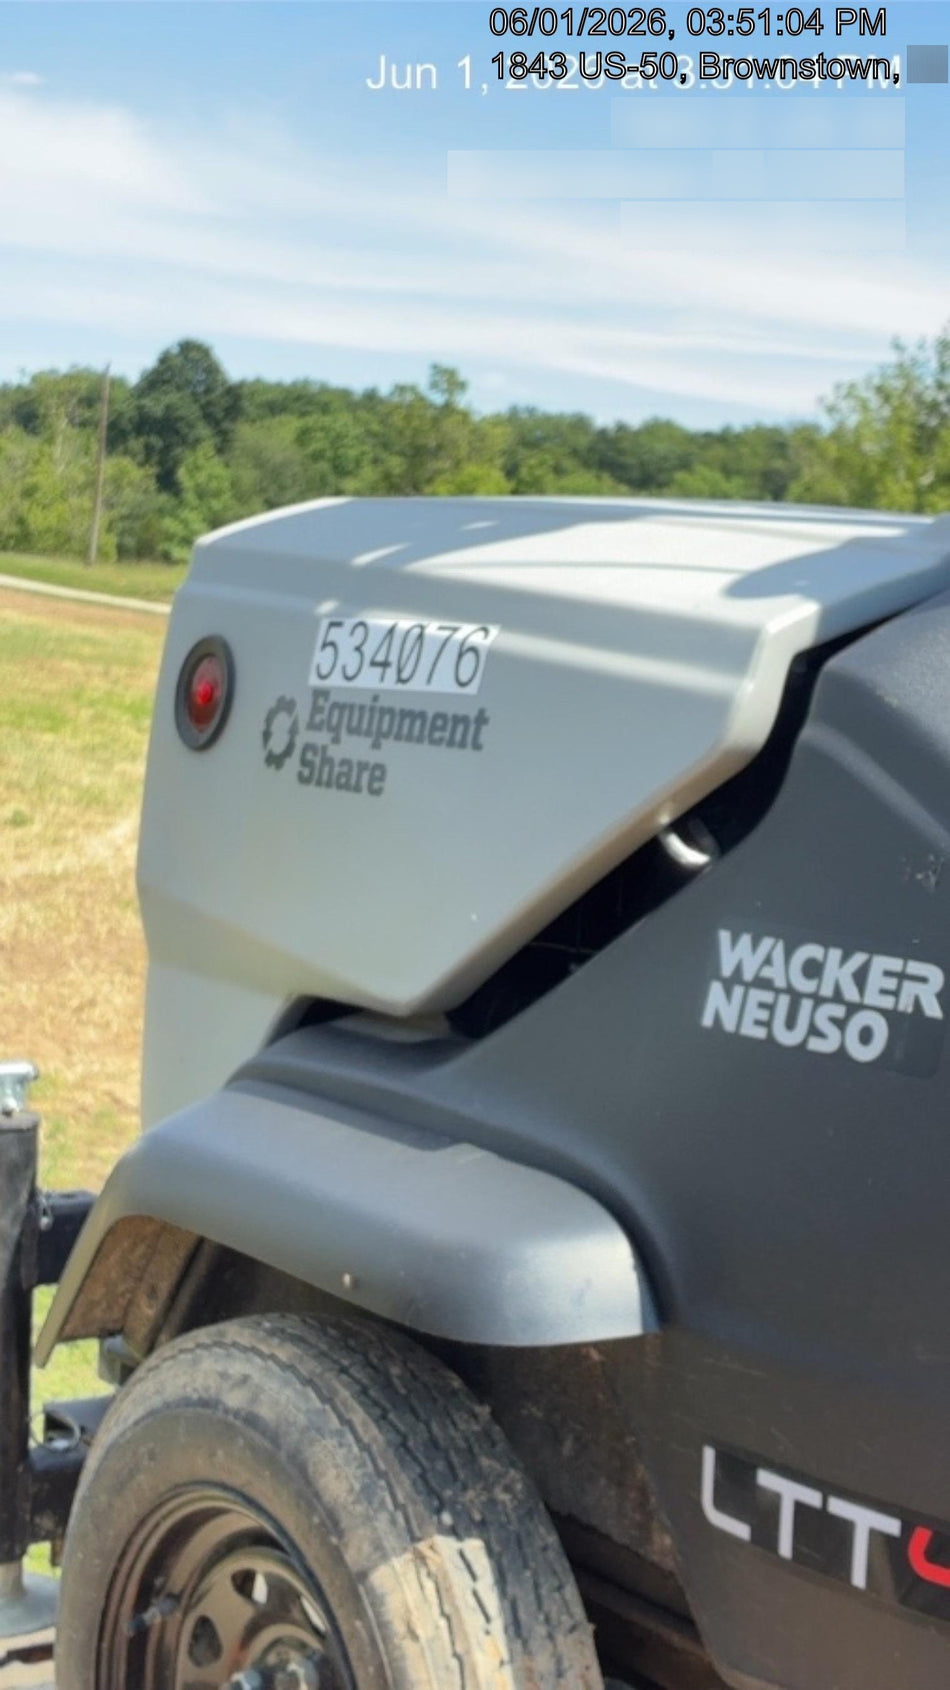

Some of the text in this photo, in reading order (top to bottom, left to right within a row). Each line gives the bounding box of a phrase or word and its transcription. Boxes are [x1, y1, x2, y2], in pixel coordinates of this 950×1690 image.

[315, 619, 490, 689] 534076
[305, 688, 490, 751] Equipment
[297, 742, 388, 797] Share
[718, 929, 944, 1020] WACKER
